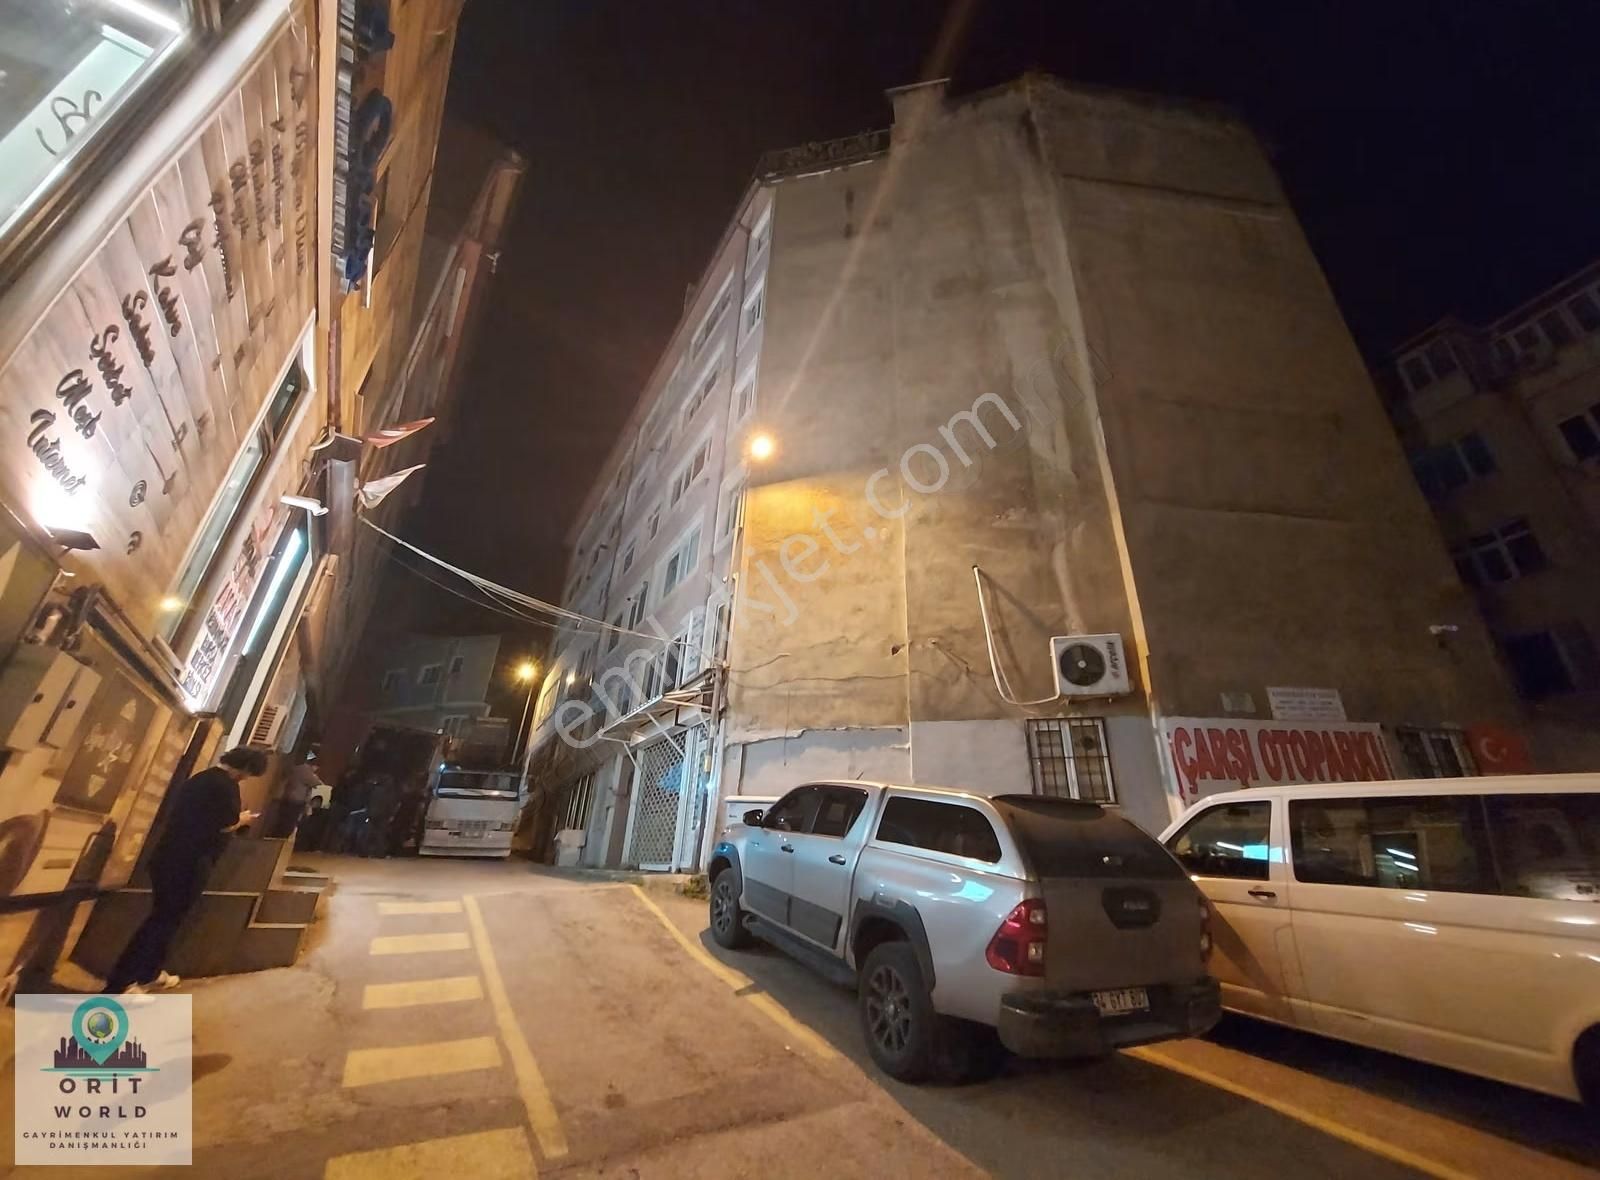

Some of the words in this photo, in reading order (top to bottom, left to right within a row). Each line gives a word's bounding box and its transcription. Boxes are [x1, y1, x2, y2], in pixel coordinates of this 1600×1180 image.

[148, 253, 181, 338] Kahve
[1173, 726, 1260, 795] ÇARŞI
[1257, 729, 1388, 782] OTOPARKI
